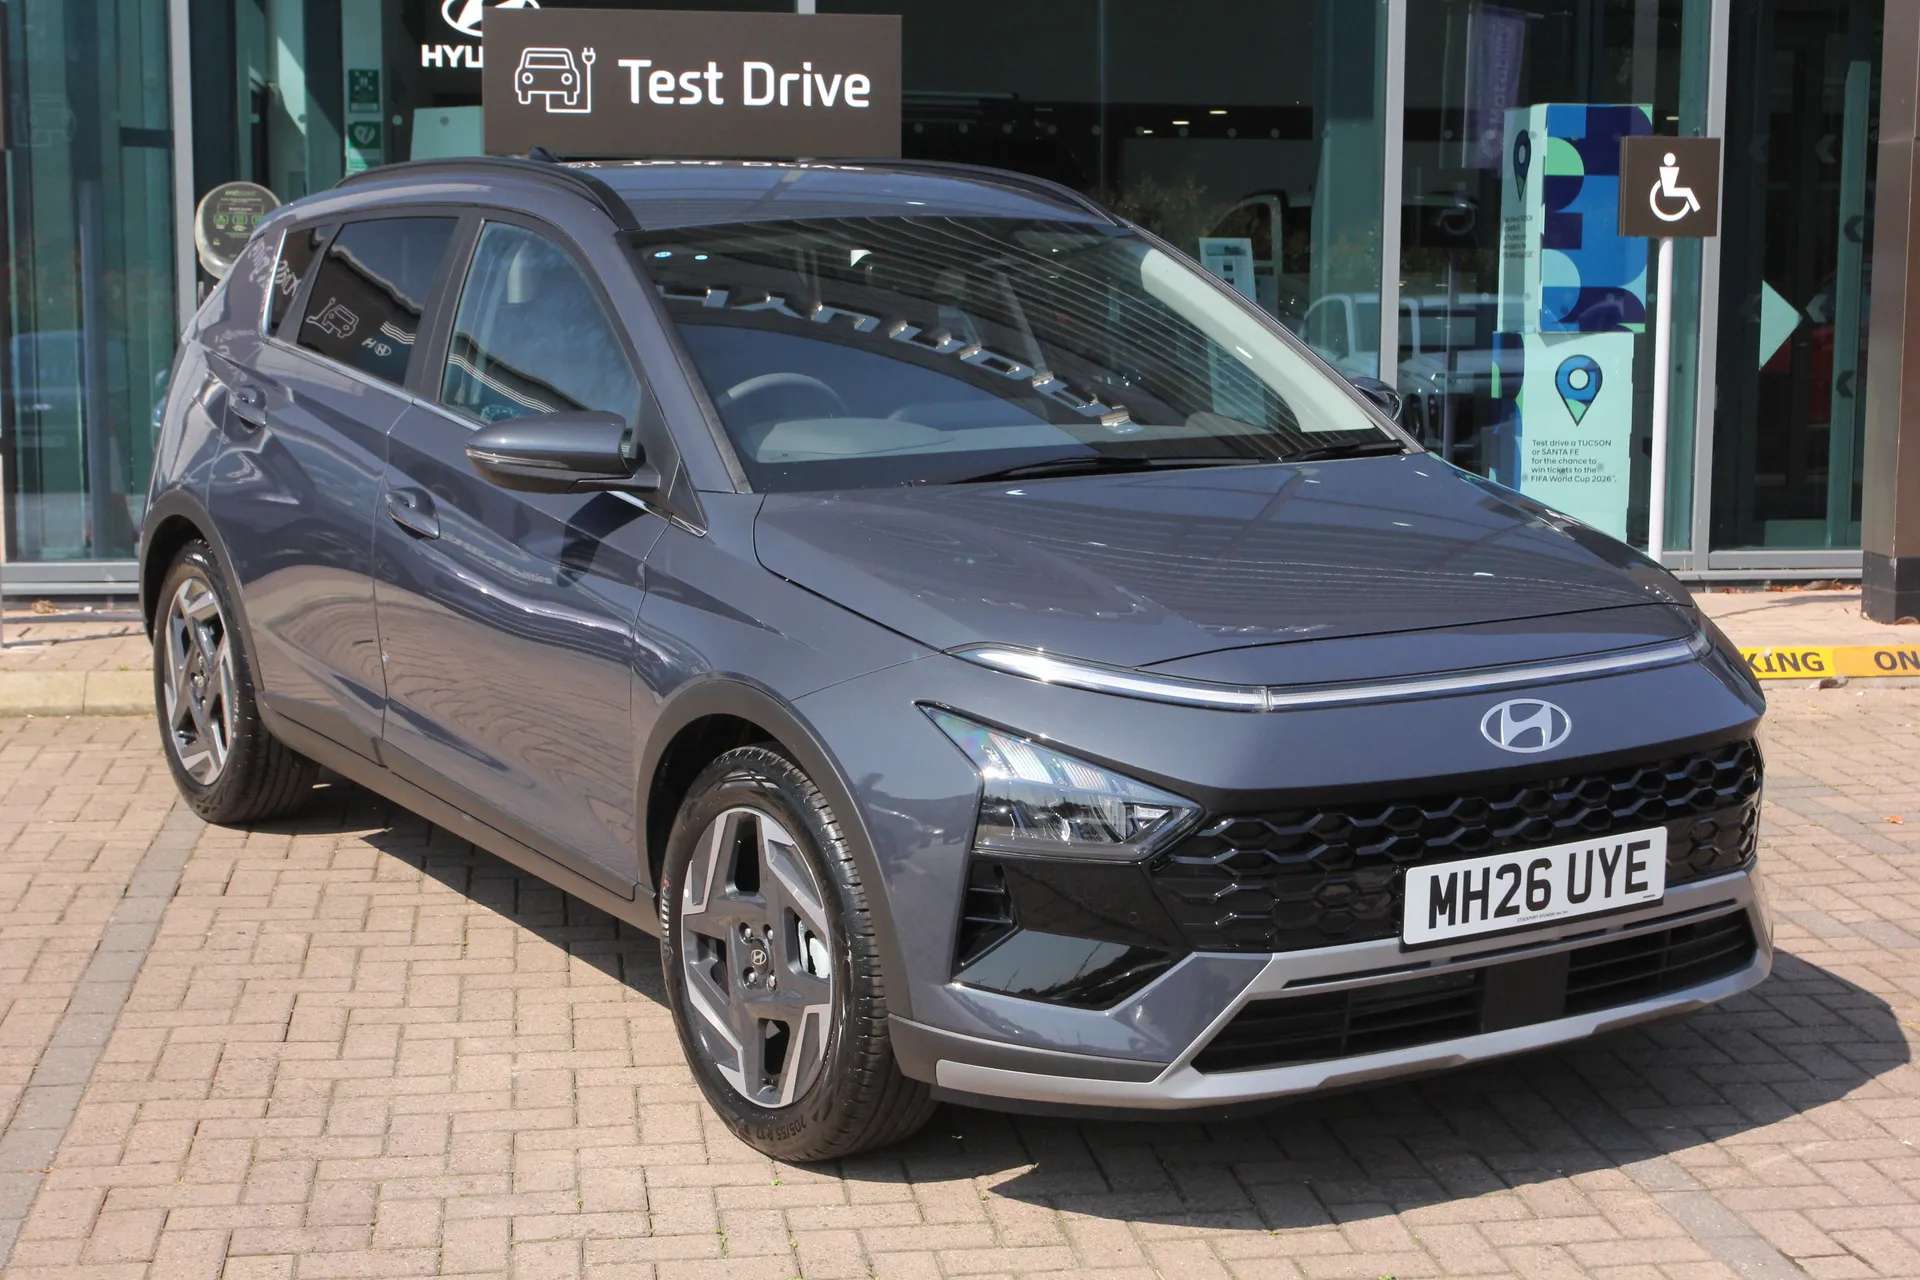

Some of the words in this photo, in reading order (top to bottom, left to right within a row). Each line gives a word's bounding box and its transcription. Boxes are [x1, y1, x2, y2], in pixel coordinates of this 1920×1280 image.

[421, 44, 483, 68] HYU
[618, 59, 724, 105] Test
[743, 61, 871, 108] Drive
[1532, 439, 1548, 447] Test
[1549, 439, 1570, 447] drive
[1578, 439, 1612, 447] TUCSON
[1541, 448, 1568, 456] SANTA
[1569, 448, 1580, 456] FE
[1531, 457, 1542, 465] for
[1543, 457, 1557, 465] the
[1558, 457, 1588, 465] chance
[1547, 466, 1573, 474] tickets
[1583, 466, 1597, 474] the
[1530, 475, 1548, 483] FIFA
[1549, 475, 1573, 483] World
[1574, 475, 1591, 484] Cup
[1744, 651, 1825, 673] KING
[1874, 650, 1920, 671] ON
[1428, 857, 1553, 930] MH26
[1566, 839, 1651, 905] UYE
